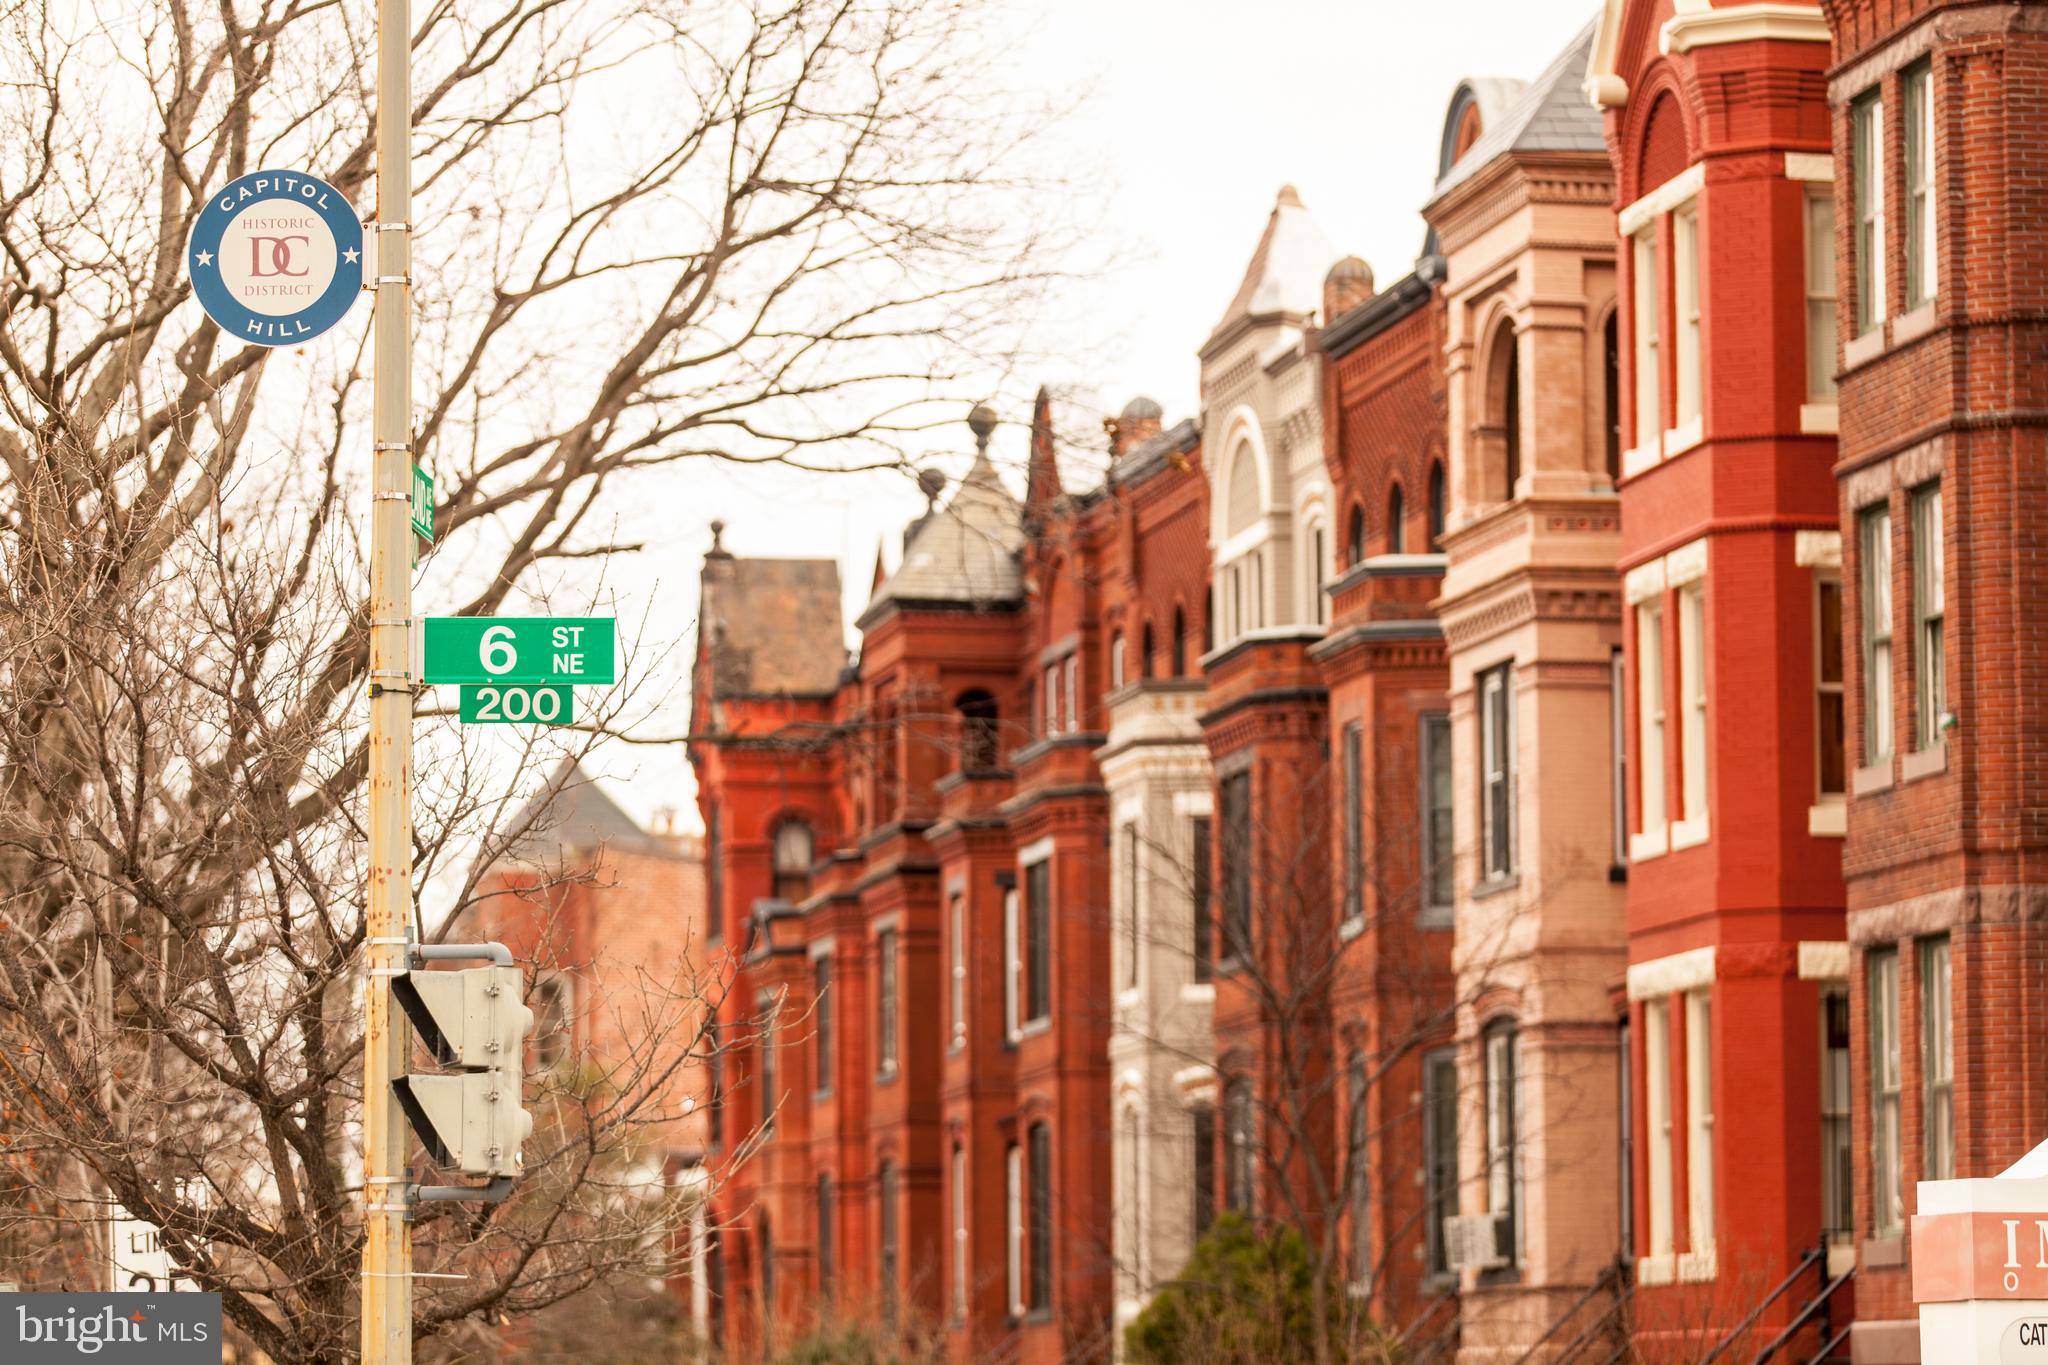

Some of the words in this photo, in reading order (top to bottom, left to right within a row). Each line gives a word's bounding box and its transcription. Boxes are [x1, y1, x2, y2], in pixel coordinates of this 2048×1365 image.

[219, 178, 330, 212] CAPITOL
[242, 218, 315, 230] HISTORIC
[248, 236, 310, 277] DC
[244, 285, 313, 296] DISTRICT
[247, 319, 311, 337] HILL
[479, 625, 518, 675] 6
[552, 626, 585, 648] ST
[552, 653, 585, 675] NE
[475, 687, 561, 721] 200
